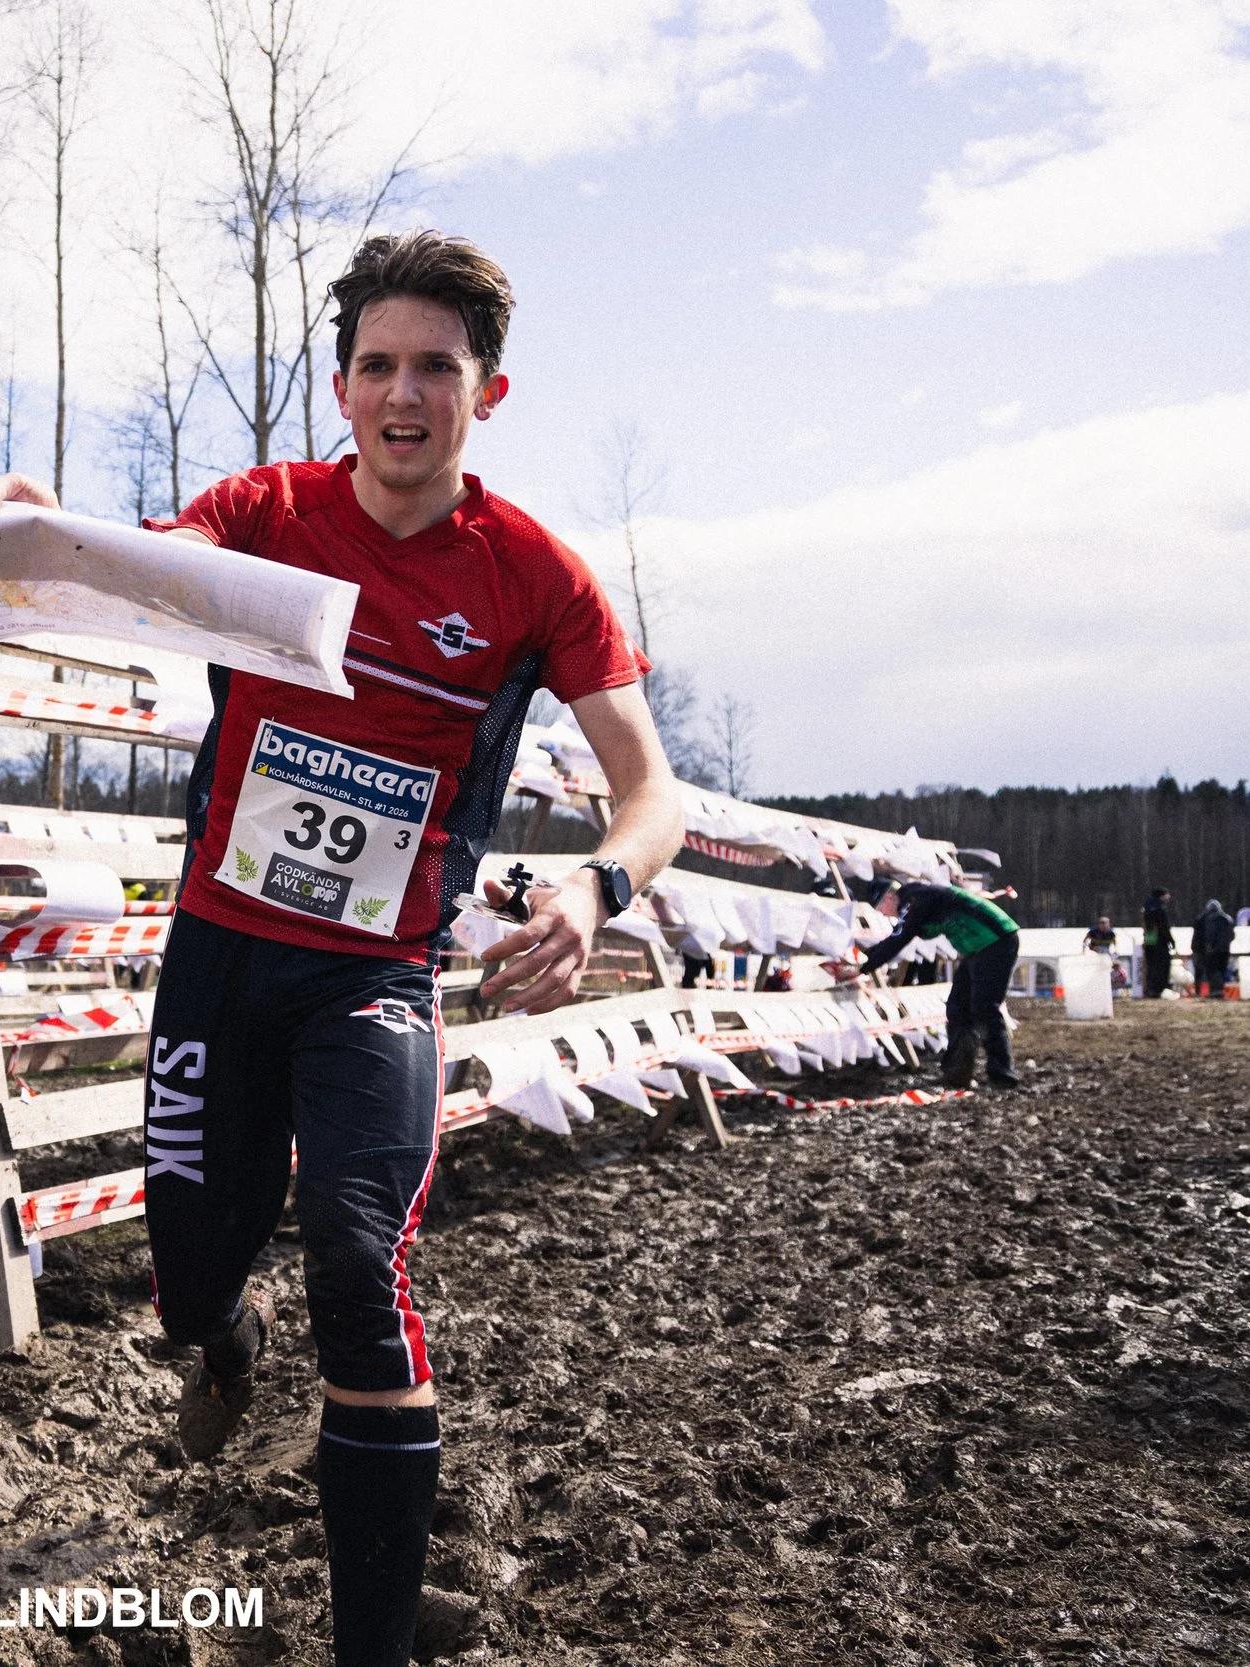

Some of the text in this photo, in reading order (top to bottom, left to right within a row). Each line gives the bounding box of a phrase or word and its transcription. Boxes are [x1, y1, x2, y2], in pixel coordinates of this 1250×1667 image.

[260, 727, 432, 801] bagheera
[268, 767, 351, 800] KOLMÅRDSKAVLEN
[358, 796, 373, 808] STL
[374, 803, 387, 812] #1
[388, 806, 409, 818] 2026
[283, 802, 367, 864] 39
[394, 830, 411, 850] 3
[276, 862, 341, 891] GODKÄNDA
[281, 891, 314, 906] SVERIGE
[147, 1036, 206, 1184] SAIK
